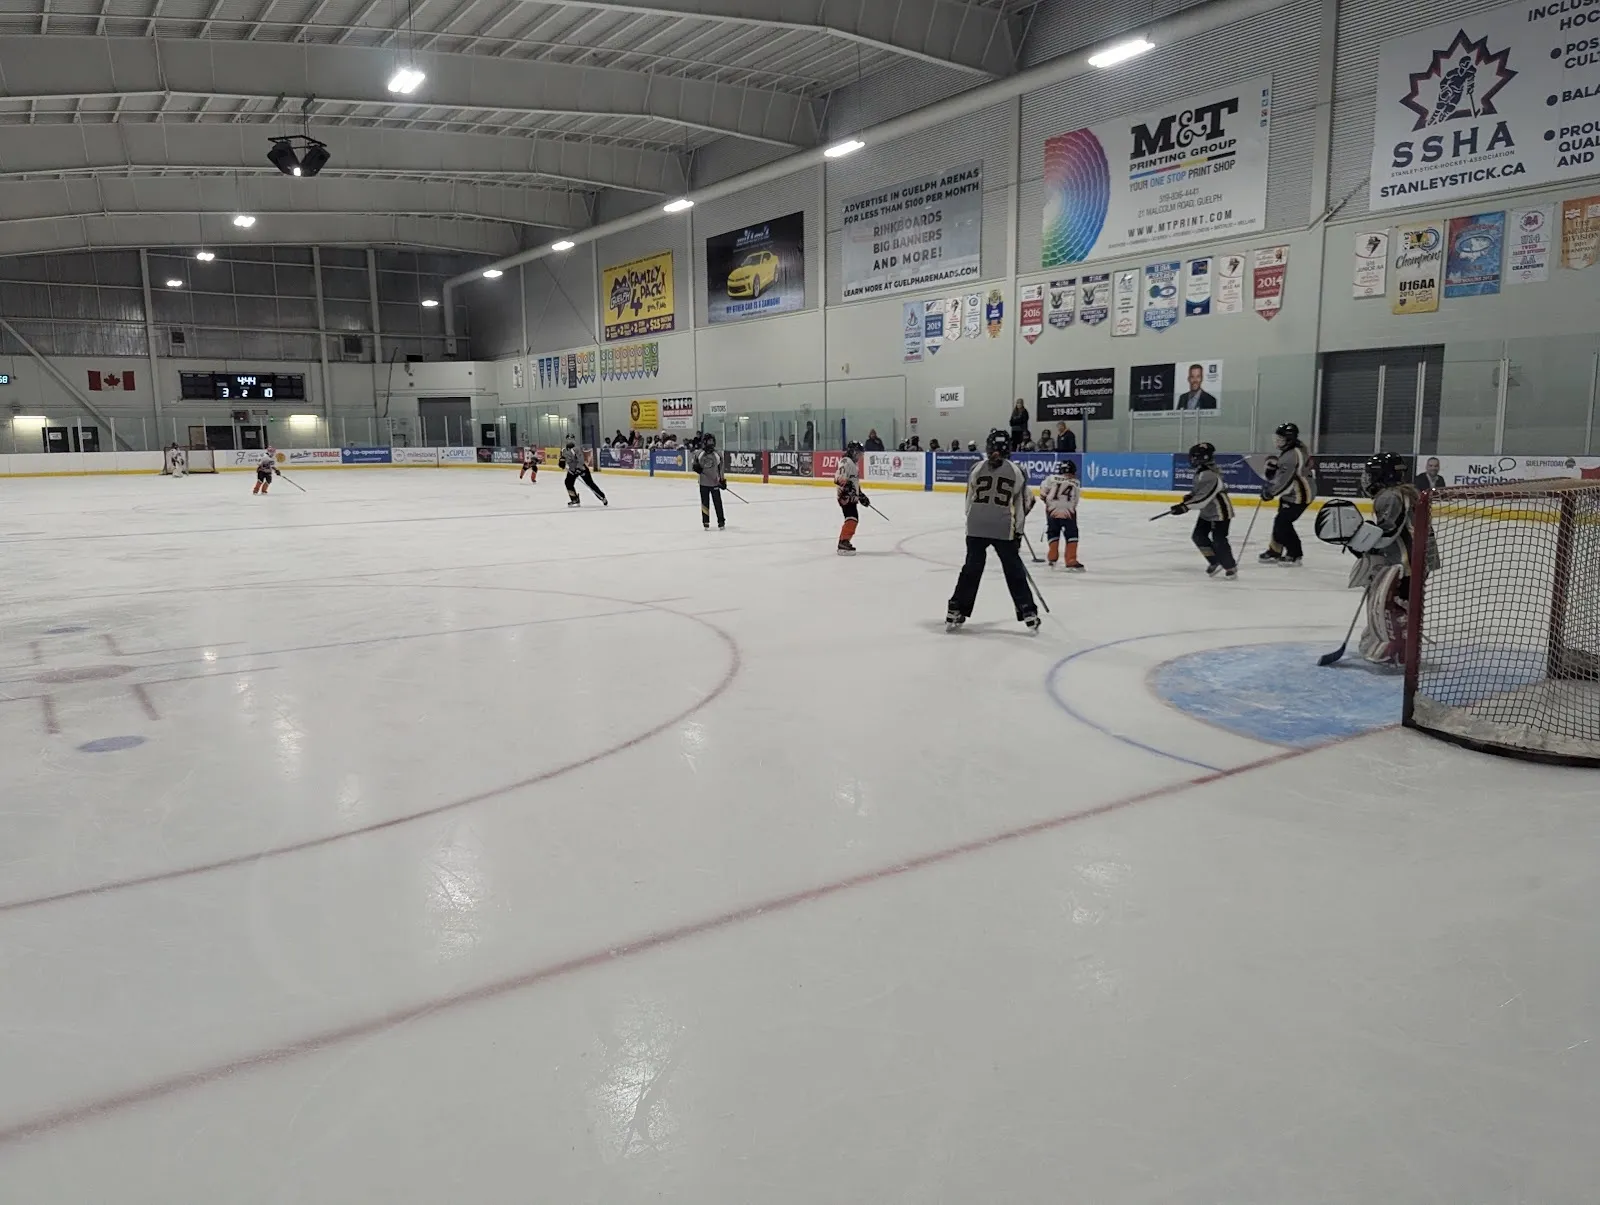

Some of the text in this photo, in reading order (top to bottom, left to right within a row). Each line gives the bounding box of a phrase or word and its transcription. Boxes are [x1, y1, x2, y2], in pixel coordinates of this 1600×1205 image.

[1527, 0, 1600, 22] INCLUS
[1566, 37, 1600, 55] POS
[1130, 98, 1239, 160] M&T
[1391, 120, 1515, 168] SSHA
[1129, 138, 1237, 172] PRINTING GROUP
[1557, 151, 1594, 167] AND
[1129, 159, 1236, 192] YOUR ONE STOP PRINT SHOP
[1380, 162, 1526, 198] STANLEYSTICK.CA
[844, 168, 979, 213] ADVERTISE IN GUELPH ARENAS
[844, 182, 979, 225] FOR LESS THAN $100 PER MONTH
[873, 210, 942, 237] RINKBOARDS
[1128, 210, 1233, 237] WWW.MTPRINT.COM
[873, 229, 942, 254] BIG BANNERS
[873, 246, 942, 271] AND MORE!
[630, 265, 661, 286] FAMILY
[844, 266, 978, 297] LEARN MORE AT GUELPHARENAADS.COM
[1399, 279, 1435, 291] U16AA
[641, 282, 661, 299] PACK
[1038, 378, 1072, 398] T&M
[1074, 377, 1112, 386] Construction
[1080, 387, 1113, 395] Renovation
[222, 388, 230, 398] 3
[242, 390, 248, 398] 2
[940, 392, 959, 402] HOME
[730, 453, 756, 467] M&T
[1468, 465, 1496, 475] Nick
[974, 475, 1015, 507] 25
[1053, 483, 1073, 502] 14
